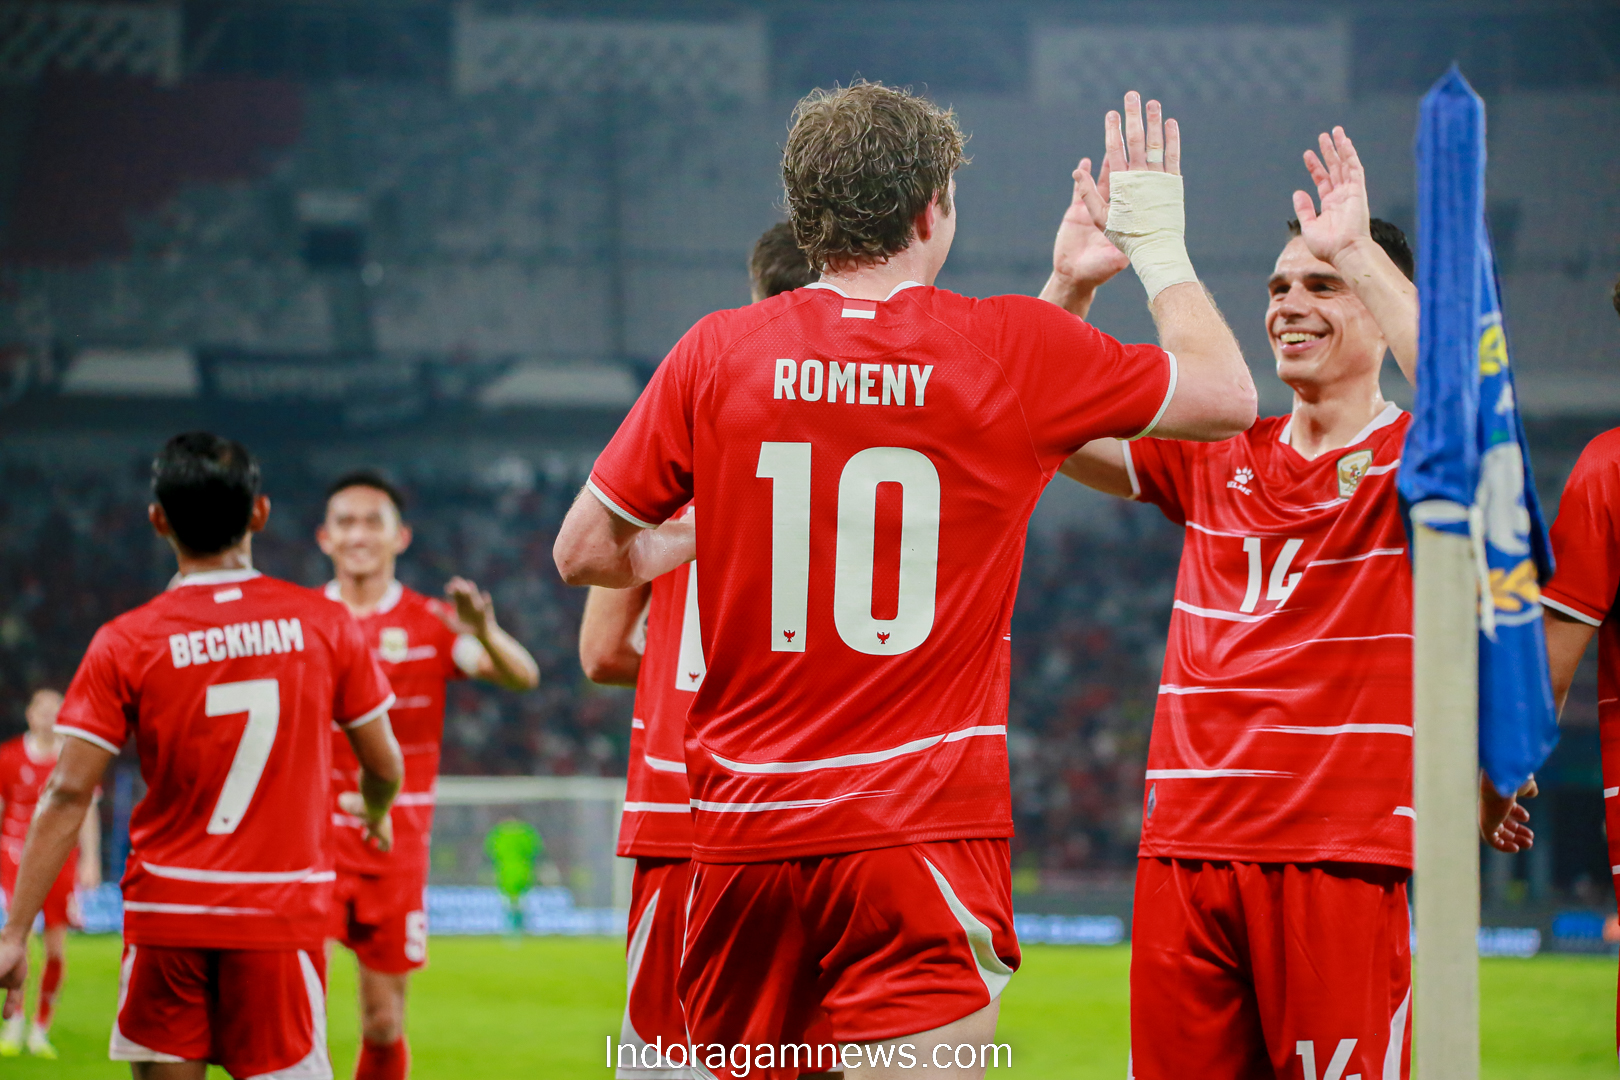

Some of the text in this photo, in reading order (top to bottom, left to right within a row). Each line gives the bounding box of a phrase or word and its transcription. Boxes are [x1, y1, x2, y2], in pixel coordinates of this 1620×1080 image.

[773, 358, 934, 407] ROMENY
[755, 441, 941, 656] 10
[1239, 537, 1305, 613] 14
[169, 617, 305, 669] BECKHAM
[205, 678, 280, 834] 7
